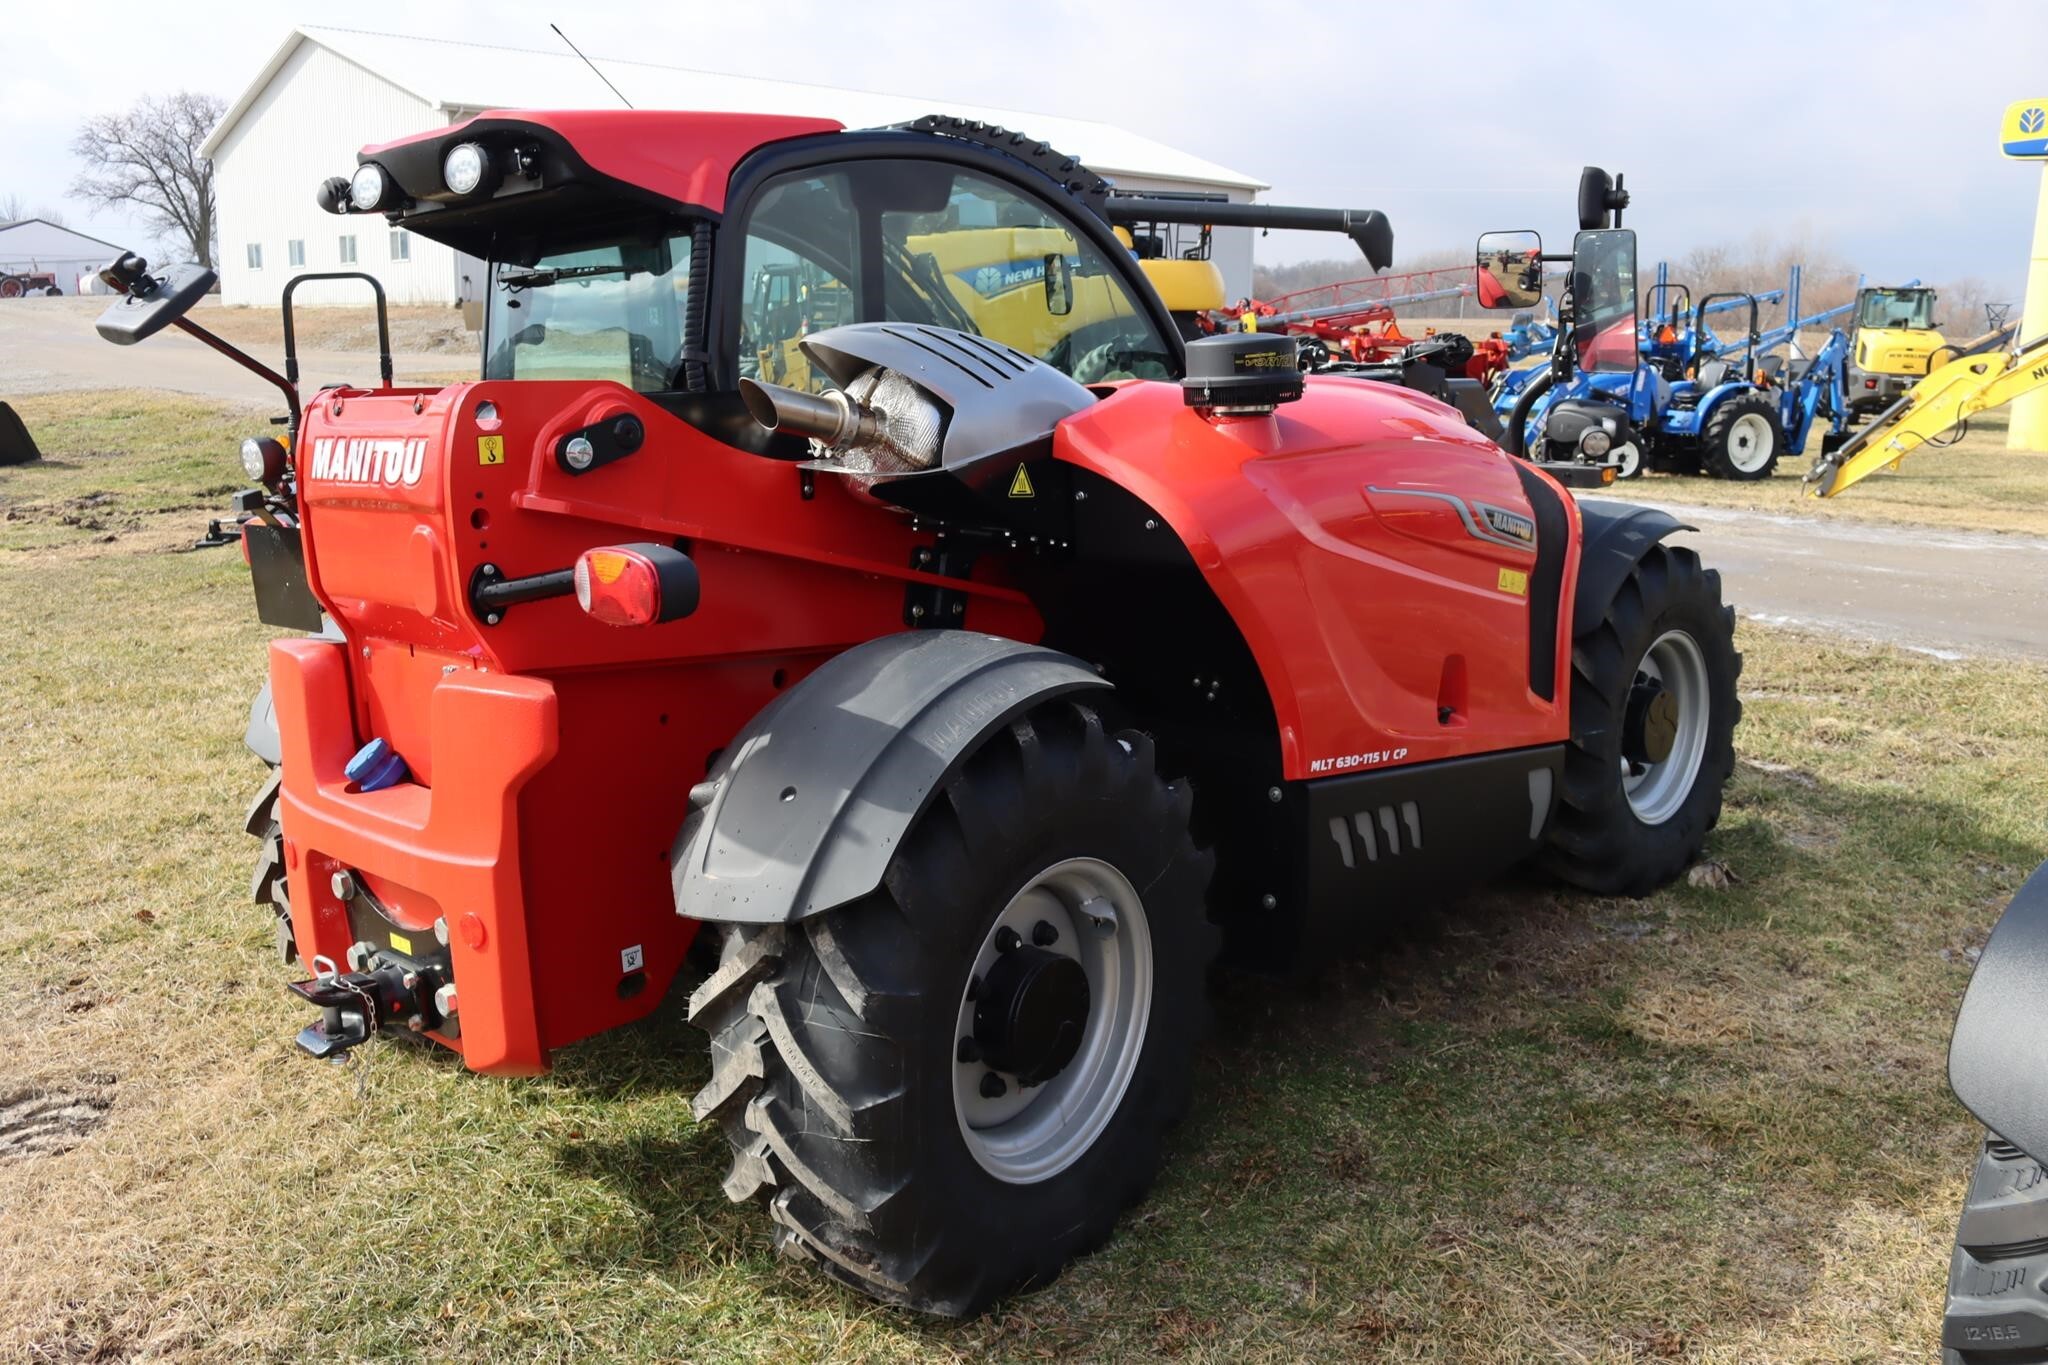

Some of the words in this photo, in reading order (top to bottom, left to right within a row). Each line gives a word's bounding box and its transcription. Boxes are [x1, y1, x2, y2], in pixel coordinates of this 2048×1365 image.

[1005, 270, 1034, 285] NEW
[311, 437, 427, 486] MANITOU
[1493, 511, 1532, 539] MANITOU
[1310, 758, 1335, 773] MLT
[1382, 750, 1390, 762] V
[1393, 747, 1408, 760] CP
[1965, 1325, 2020, 1341] 12-16.5
